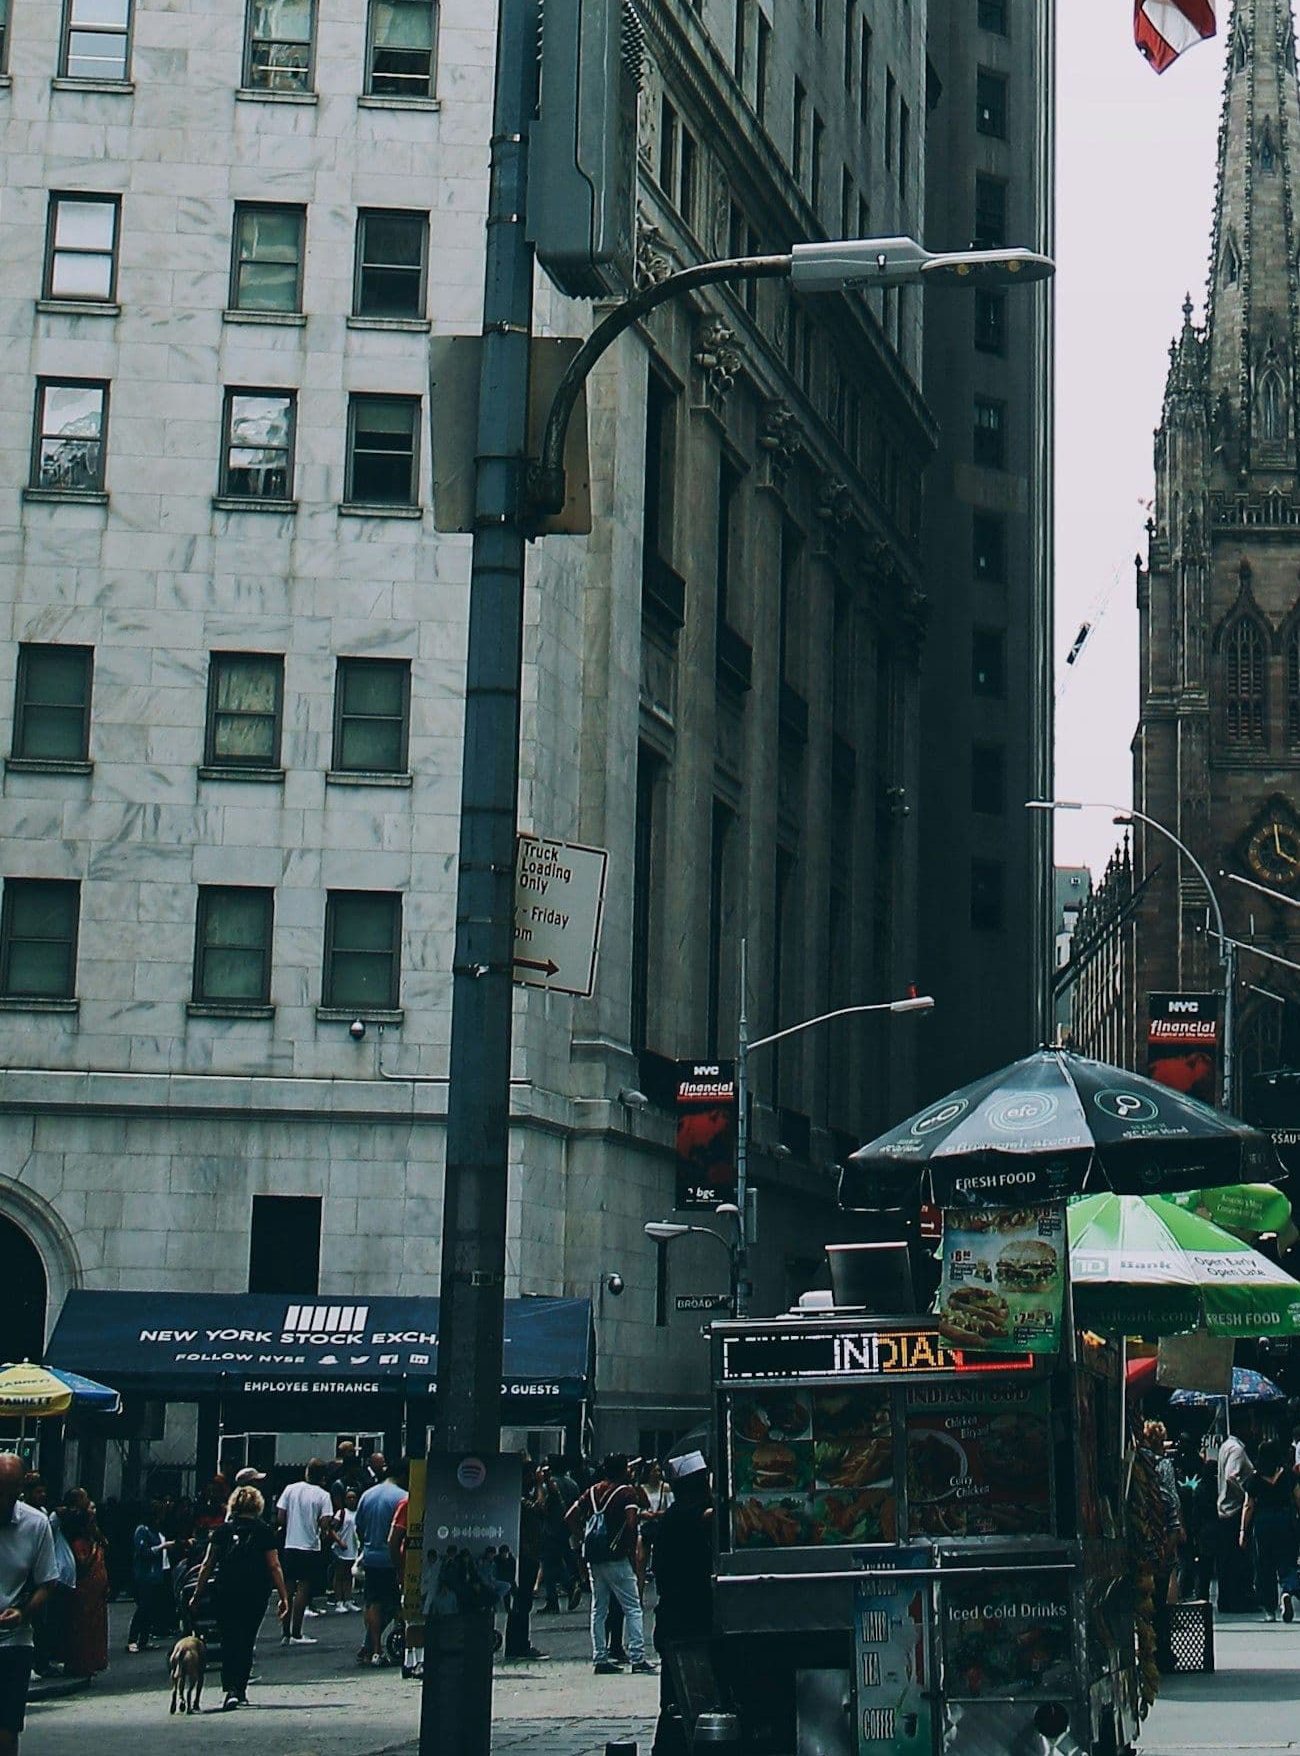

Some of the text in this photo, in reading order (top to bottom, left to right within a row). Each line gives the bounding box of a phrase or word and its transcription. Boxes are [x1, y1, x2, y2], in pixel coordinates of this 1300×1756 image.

[524, 842, 559, 862] Truck
[521, 858, 571, 884] Loading
[520, 873, 549, 895] Only
[531, 906, 569, 929] Friday
[1168, 1000, 1200, 1013] NYC
[1150, 1019, 1217, 1035] financial
[693, 1065, 719, 1076] NYC
[679, 1081, 734, 1096] financial
[956, 1175, 997, 1190] FRESH
[999, 1171, 1036, 1187] FOOD
[696, 1186, 715, 1200] bgc
[1120, 1259, 1172, 1270] Bank
[1194, 1256, 1257, 1267] Open Early
[1207, 1267, 1266, 1278] Open Late
[677, 1299, 713, 1309] BROAD
[1206, 1312, 1241, 1326] FRESH
[1245, 1312, 1280, 1325] FOOD
[139, 1329, 199, 1342] NEW
[205, 1328, 273, 1343] YORK
[279, 1332, 364, 1345] STOCK
[174, 1351, 254, 1362] FOLLOW
[258, 1354, 307, 1364] NYSE
[243, 1381, 380, 1393] EMPLOYEE ENTRANCE
[510, 1384, 560, 1395] GUESTS
[906, 1387, 975, 1405] INDIAN
[949, 1602, 1068, 1621] Iced Cold Drinks
[862, 1610, 889, 1643] WATER
[862, 1651, 881, 1686] TEA
[863, 1708, 896, 1740] COFFEE
